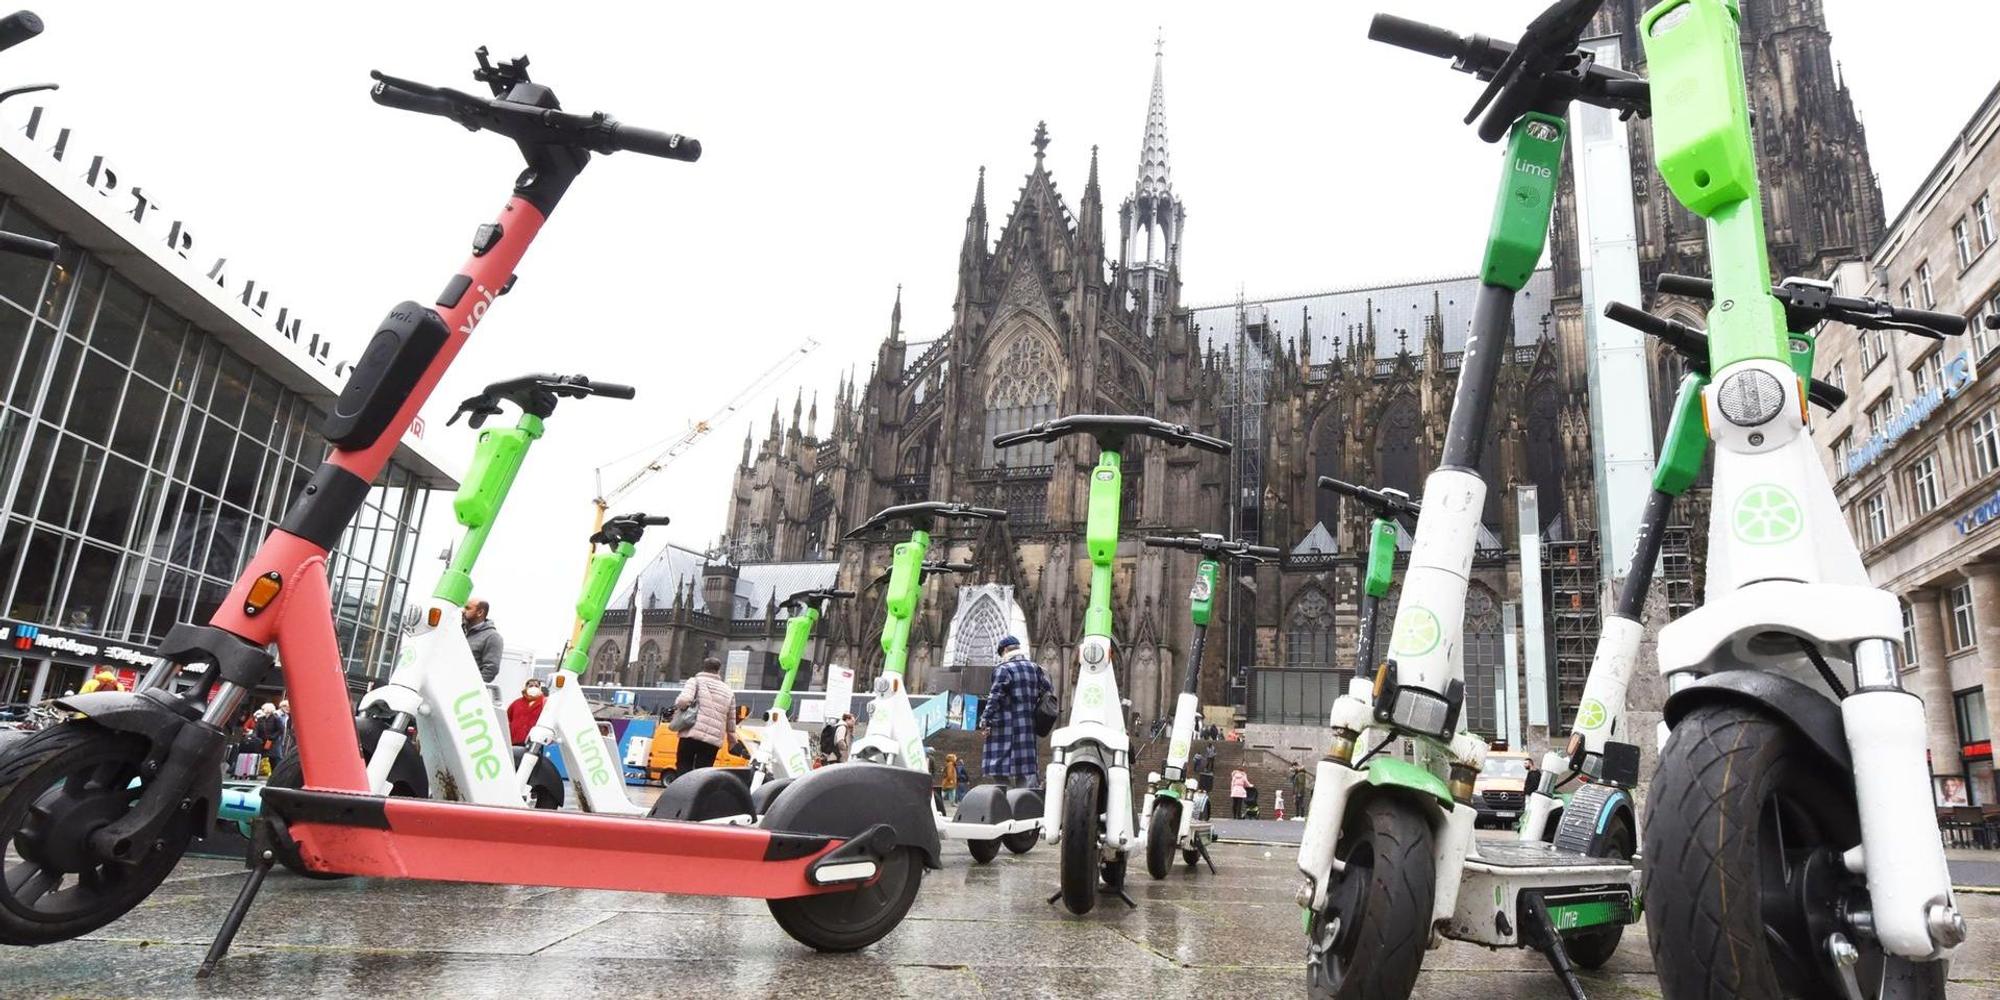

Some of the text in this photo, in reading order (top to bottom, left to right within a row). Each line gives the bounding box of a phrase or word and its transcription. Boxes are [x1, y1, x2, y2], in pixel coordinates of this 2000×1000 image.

[1515, 158, 1552, 178] Lime
[454, 689, 501, 781] Lime
[576, 728, 610, 786] Lime
[1557, 906, 1578, 930] Lime
